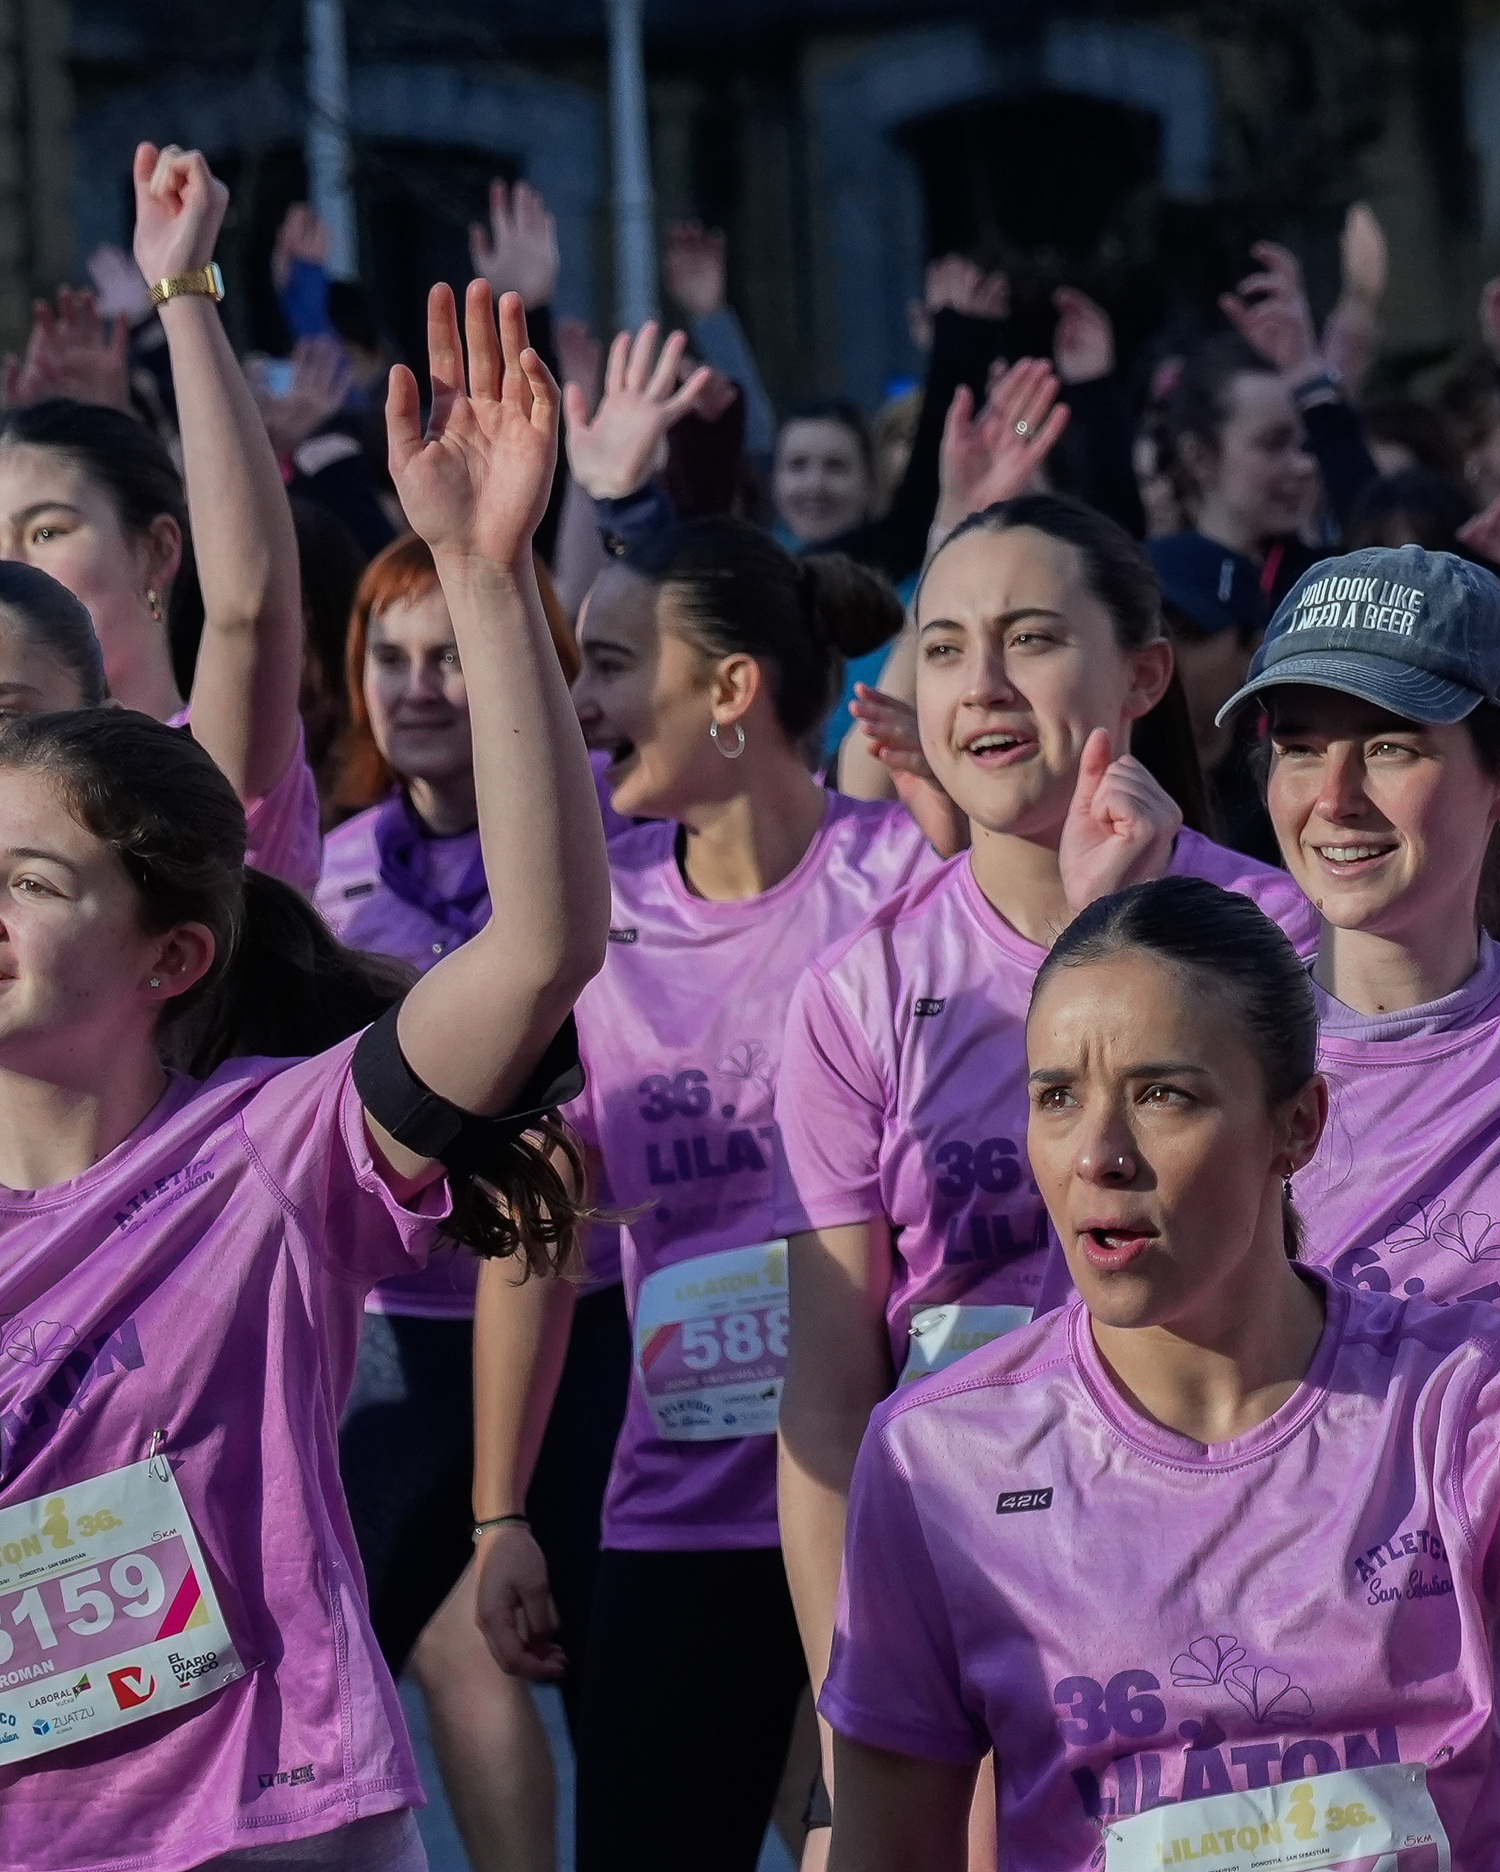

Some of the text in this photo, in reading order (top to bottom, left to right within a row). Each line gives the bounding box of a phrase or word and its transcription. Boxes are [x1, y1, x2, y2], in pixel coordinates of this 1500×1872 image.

[1296, 577, 1424, 613] YOU LOOK LIKE
[1287, 602, 1416, 636] I NEED A BEER
[1001, 1492, 1049, 1509] 42K
[0, 1510, 123, 1568] ON 36.
[1367, 1577, 1402, 1606] San
[168, 1652, 185, 1664] EL
[171, 1651, 217, 1675] DIARIO
[176, 1660, 219, 1683] VASCO
[28, 1688, 72, 1708] LABORAL
[1054, 1669, 1206, 1747] 36.
[52, 1706, 96, 1729] ZUATZU
[1157, 1802, 1377, 1865] LILATON 36.
[1404, 1834, 1433, 1848] 5KM
[1250, 1856, 1283, 1869] DONOSTIA
